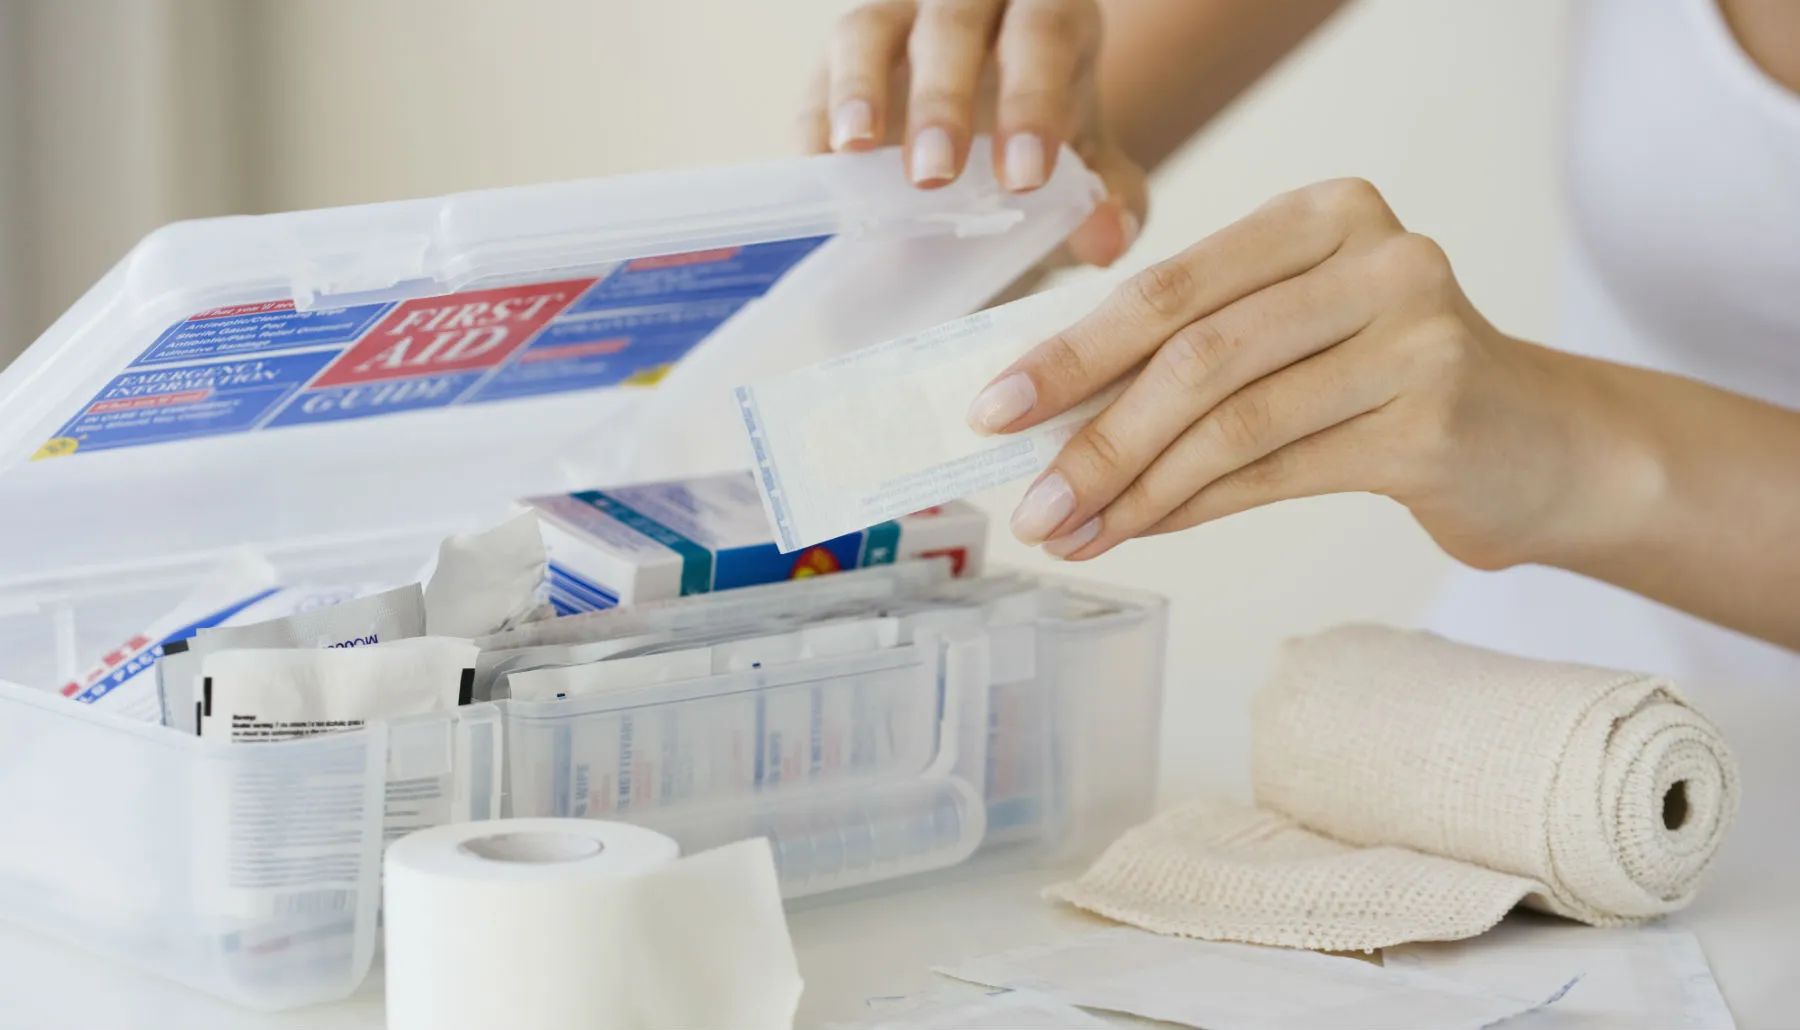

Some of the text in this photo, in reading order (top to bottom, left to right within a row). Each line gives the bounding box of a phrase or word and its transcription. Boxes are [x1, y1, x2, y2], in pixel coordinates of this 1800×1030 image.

[386, 292, 565, 335] FIRST
[355, 325, 508, 371] AID
[105, 369, 281, 399] INFORMATION
[116, 361, 269, 387] EMERGENCY
[302, 372, 461, 413] GUIDE
[575, 763, 589, 800] WIPE
